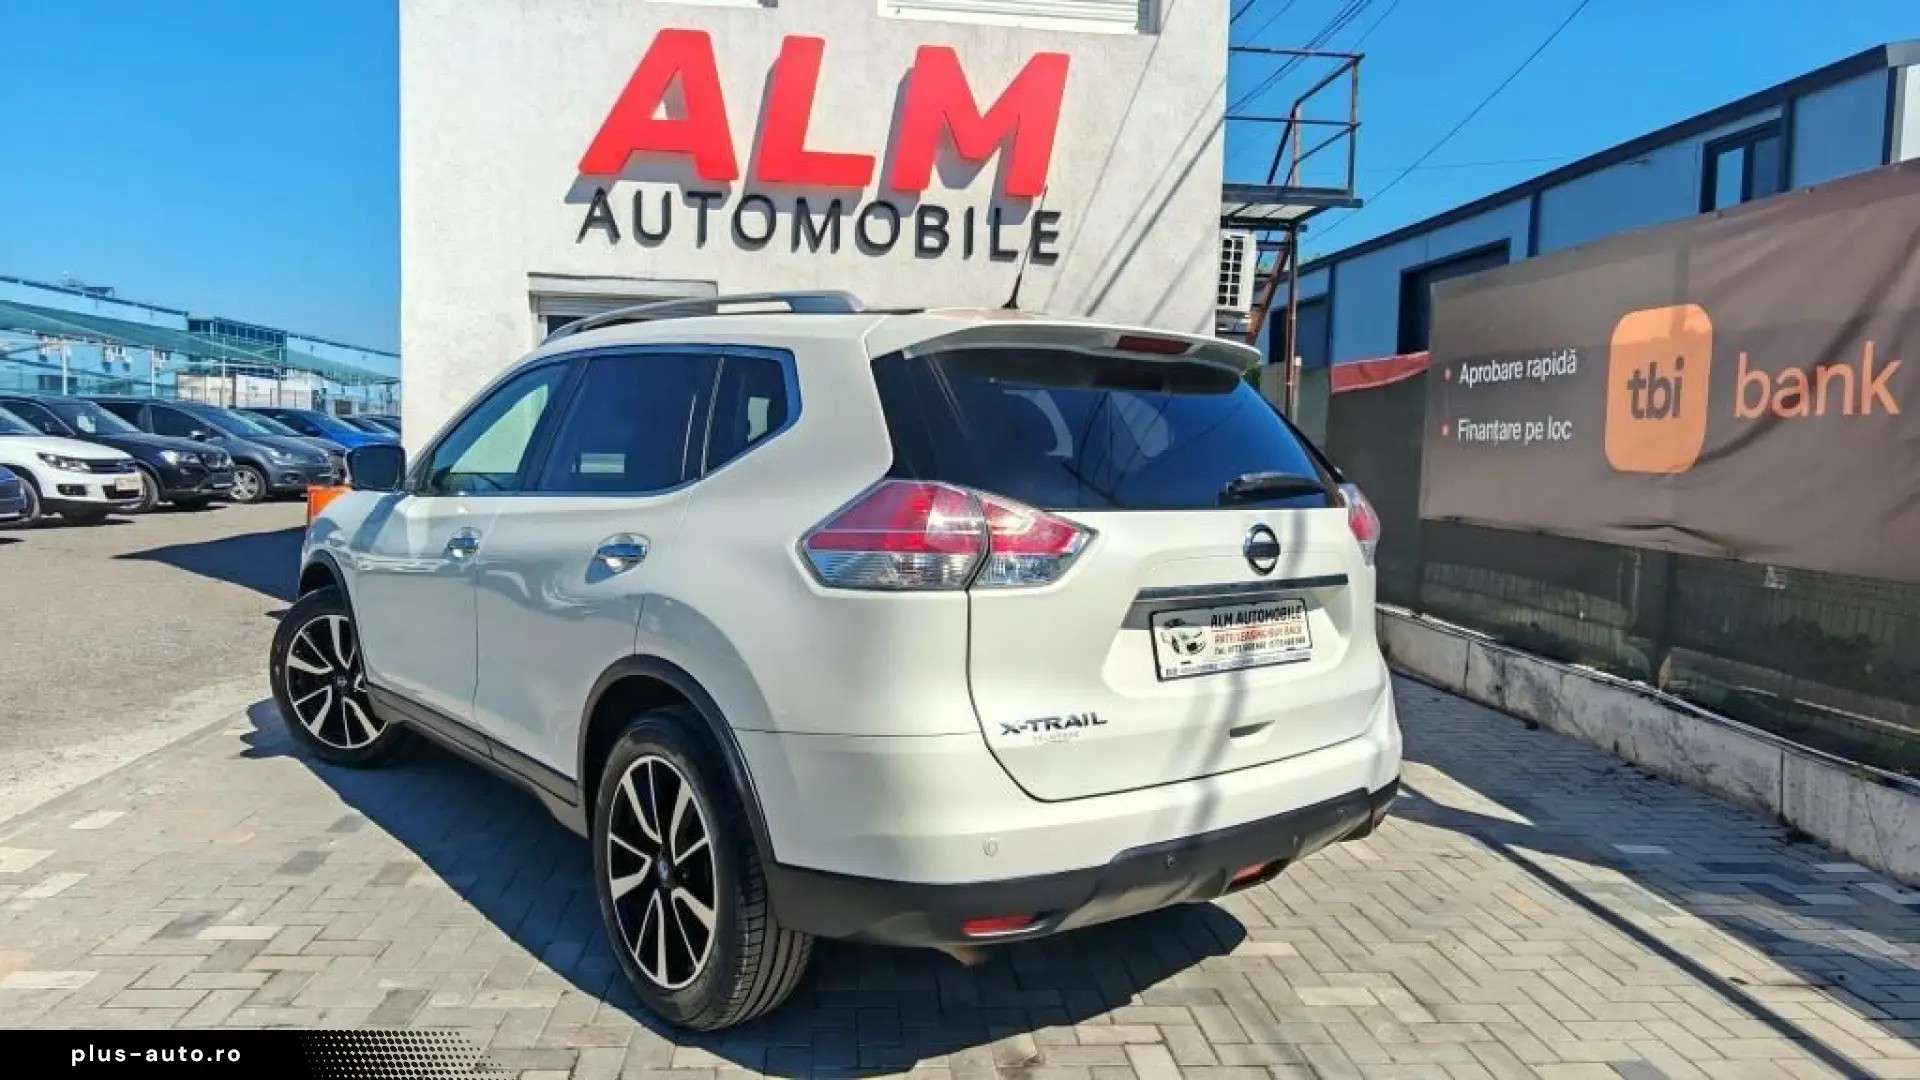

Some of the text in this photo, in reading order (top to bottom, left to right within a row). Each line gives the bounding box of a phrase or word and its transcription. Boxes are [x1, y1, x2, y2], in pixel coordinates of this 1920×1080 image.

[577, 27, 1071, 197] ALM
[576, 187, 1062, 265] AUTOMOBILE
[1458, 348, 1578, 388] Aprobare rapidă
[1626, 340, 1903, 421] tbi bank
[1523, 423, 1545, 446] pe
[1547, 414, 1573, 440] loc
[1211, 605, 1302, 628] ALM AUTOMOBILE
[999, 711, 1108, 736] X-TRAIL
